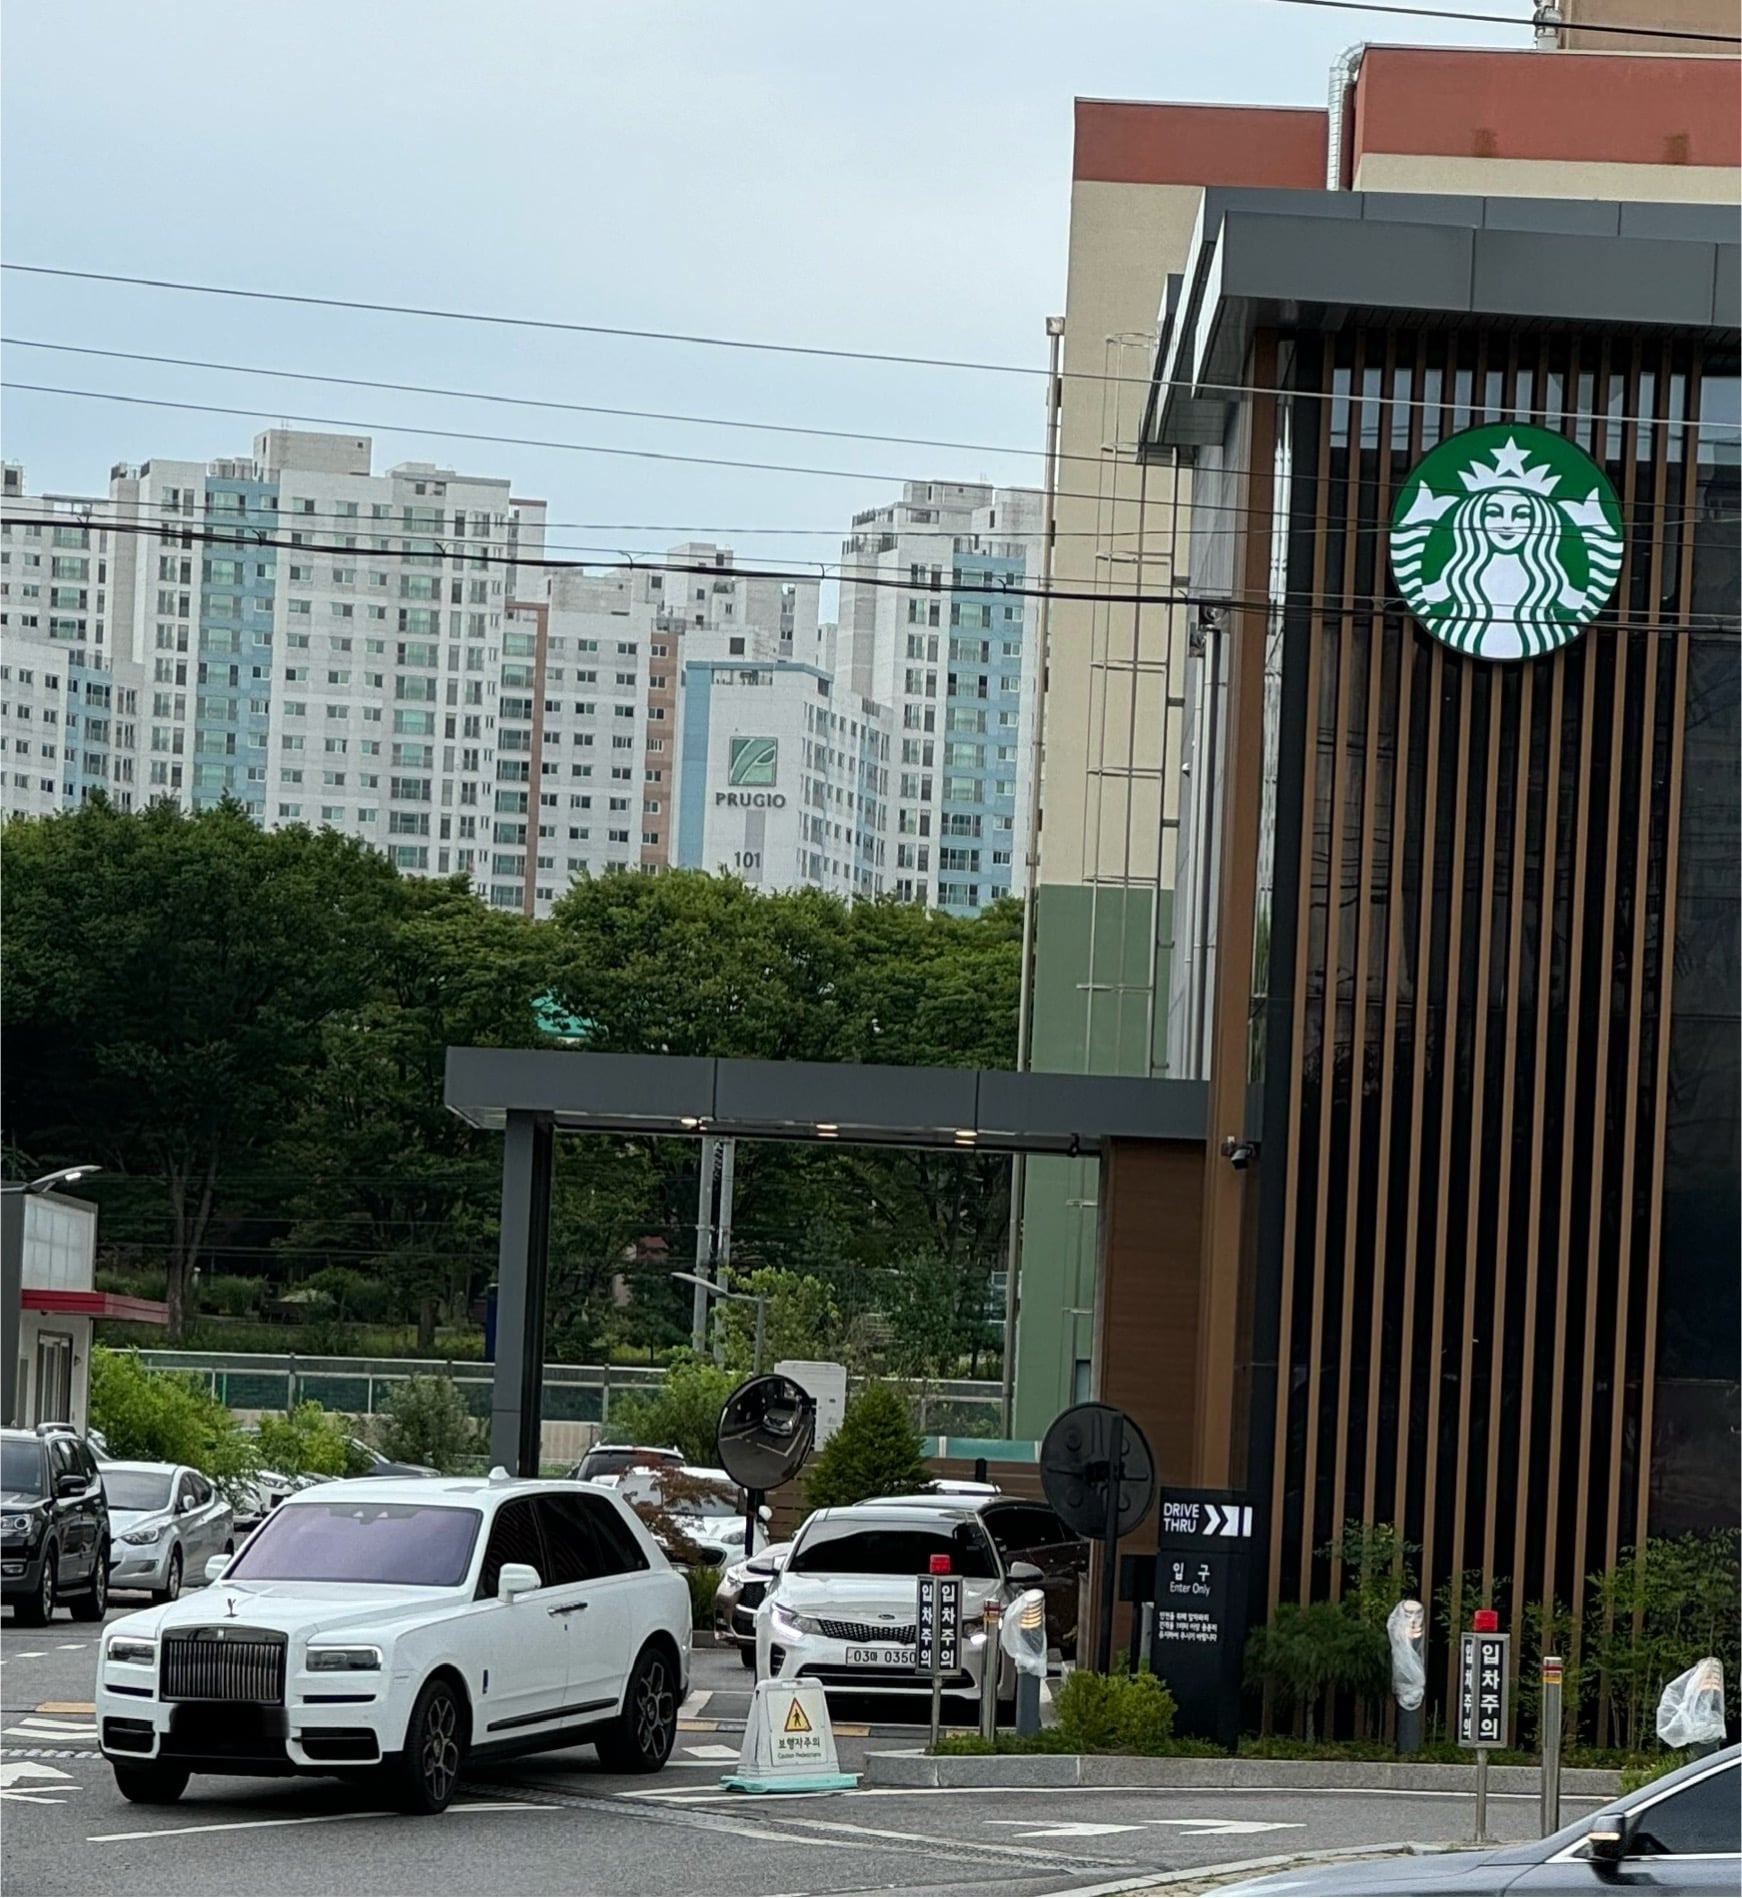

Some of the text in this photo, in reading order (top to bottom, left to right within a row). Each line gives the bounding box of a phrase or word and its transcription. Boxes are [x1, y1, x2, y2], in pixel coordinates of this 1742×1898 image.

[715, 792, 786, 809] PRUGIO
[734, 851, 761, 869] 101
[1163, 1502, 1200, 1518] DRIVE
[1163, 1517, 1197, 1534] THRU
[1169, 1581, 1211, 1597] Enter Only
[920, 1584, 933, 1668] 입차주의
[940, 1584, 956, 1669] 입차주의
[1480, 1644, 1500, 1740] 입차주의
[778, 1736, 821, 1750] 보행자주의
